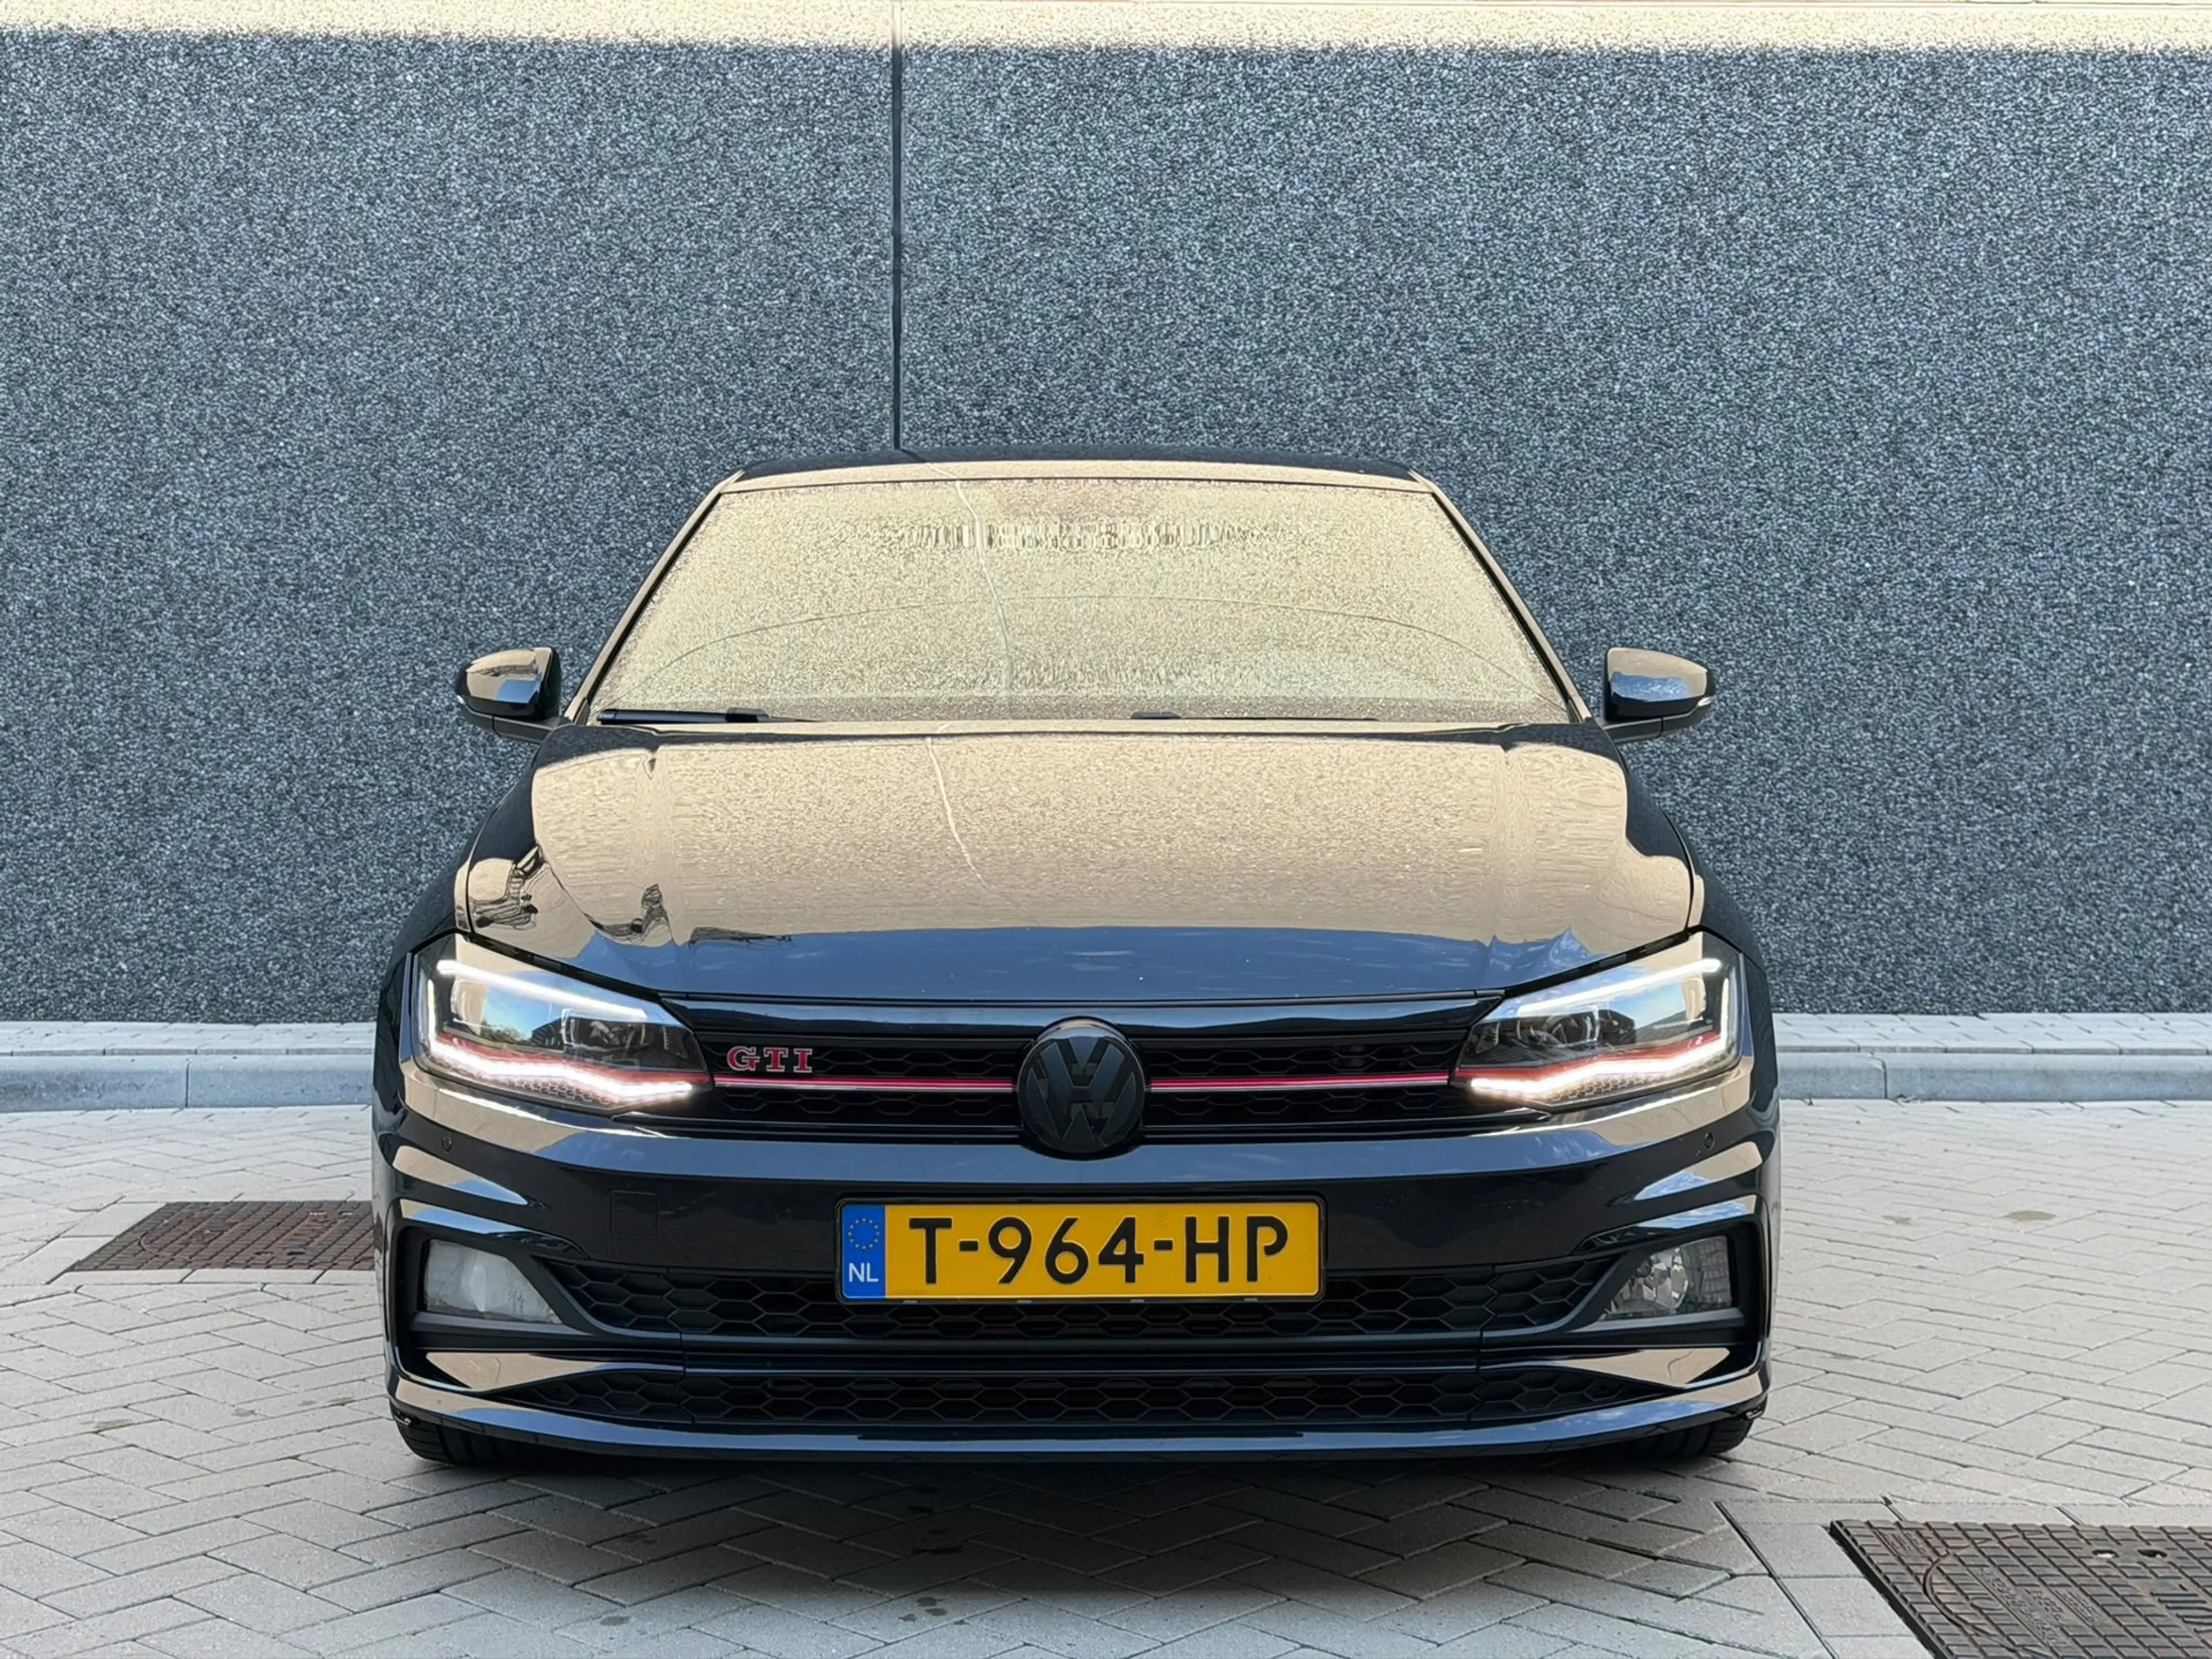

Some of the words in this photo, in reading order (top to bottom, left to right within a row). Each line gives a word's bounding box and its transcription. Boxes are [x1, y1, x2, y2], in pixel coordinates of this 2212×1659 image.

[726, 1046, 813, 1073] GTI
[1025, 1036, 1137, 1147] VW
[849, 1262, 880, 1283] NL
[908, 1215, 1290, 1285] T-964-HP
